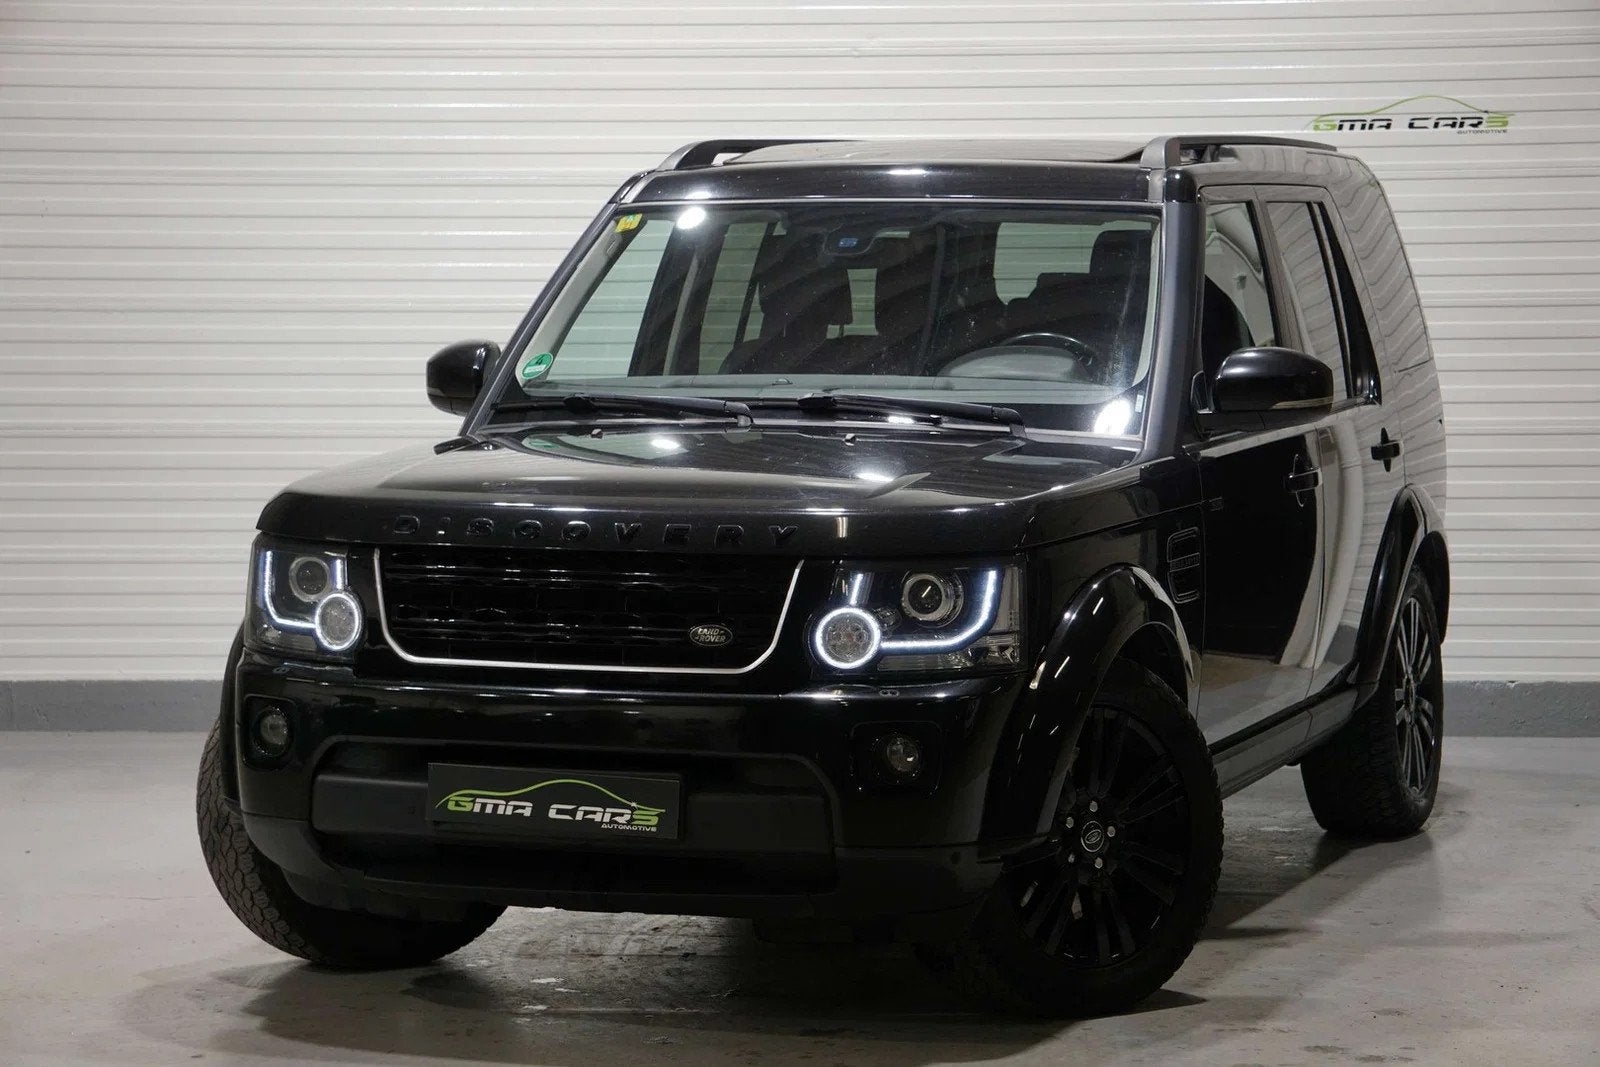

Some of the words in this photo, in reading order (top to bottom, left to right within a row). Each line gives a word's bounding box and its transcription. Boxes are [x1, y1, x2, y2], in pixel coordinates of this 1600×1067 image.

[1313, 118, 1393, 132] GMA
[1408, 115, 1510, 130] CARS
[392, 515, 799, 546] DISCOVERY
[698, 634, 727, 643] ROVER
[447, 796, 534, 817] GMA
[548, 803, 660, 826] CARS
[601, 823, 658, 833] AUTOMOTIVE
